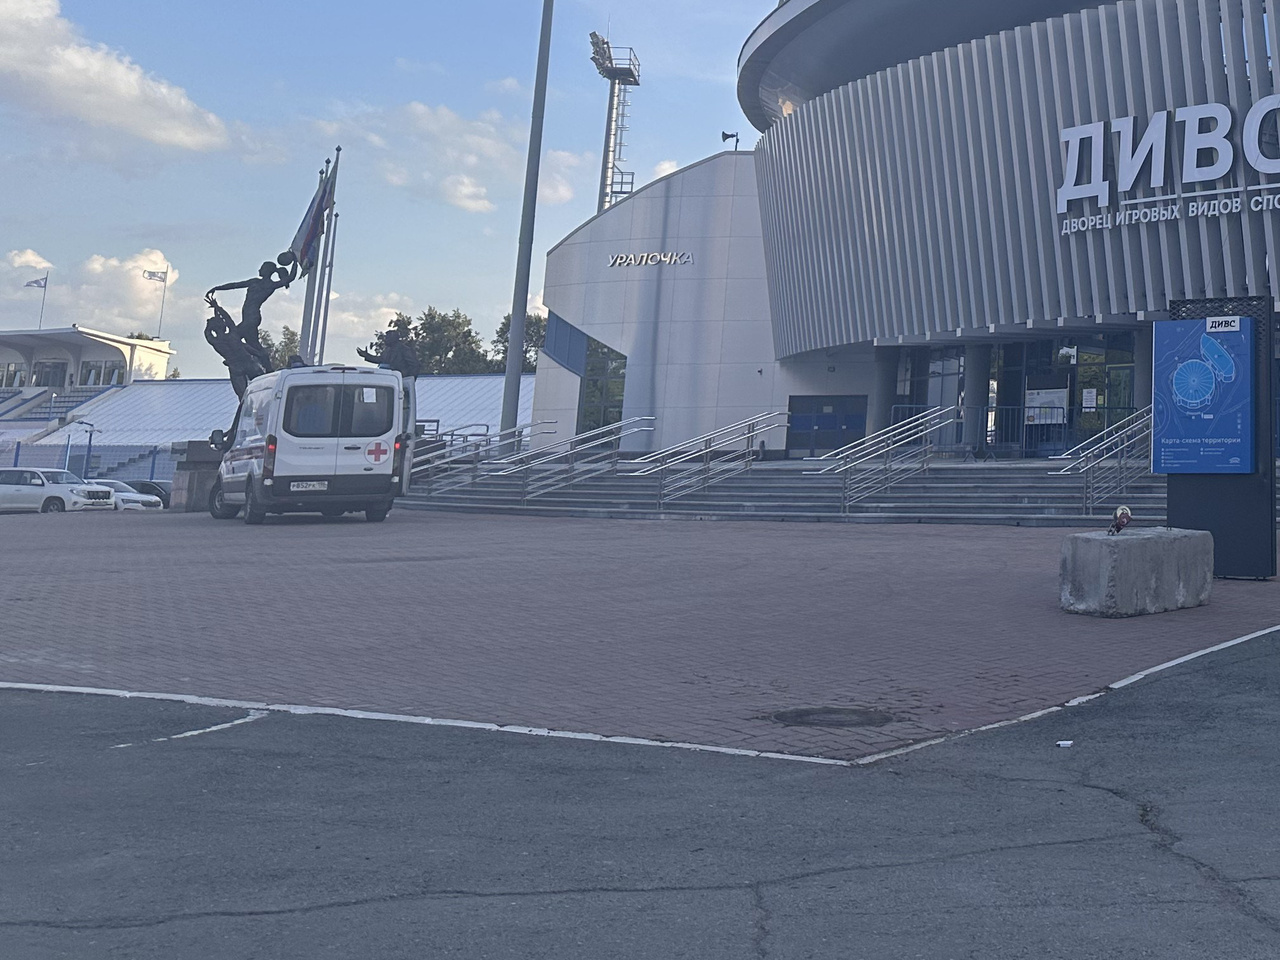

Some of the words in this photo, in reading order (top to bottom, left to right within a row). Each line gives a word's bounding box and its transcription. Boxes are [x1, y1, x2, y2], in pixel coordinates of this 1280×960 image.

[1061, 213, 1112, 235] ДВОРЕЦ
[1116, 204, 1181, 226] ИГРОВЫХ
[1188, 196, 1241, 218] ВИДОВ
[607, 252, 694, 268] УРАЛОЧКА
[1210, 320, 1236, 329] ДИВС
